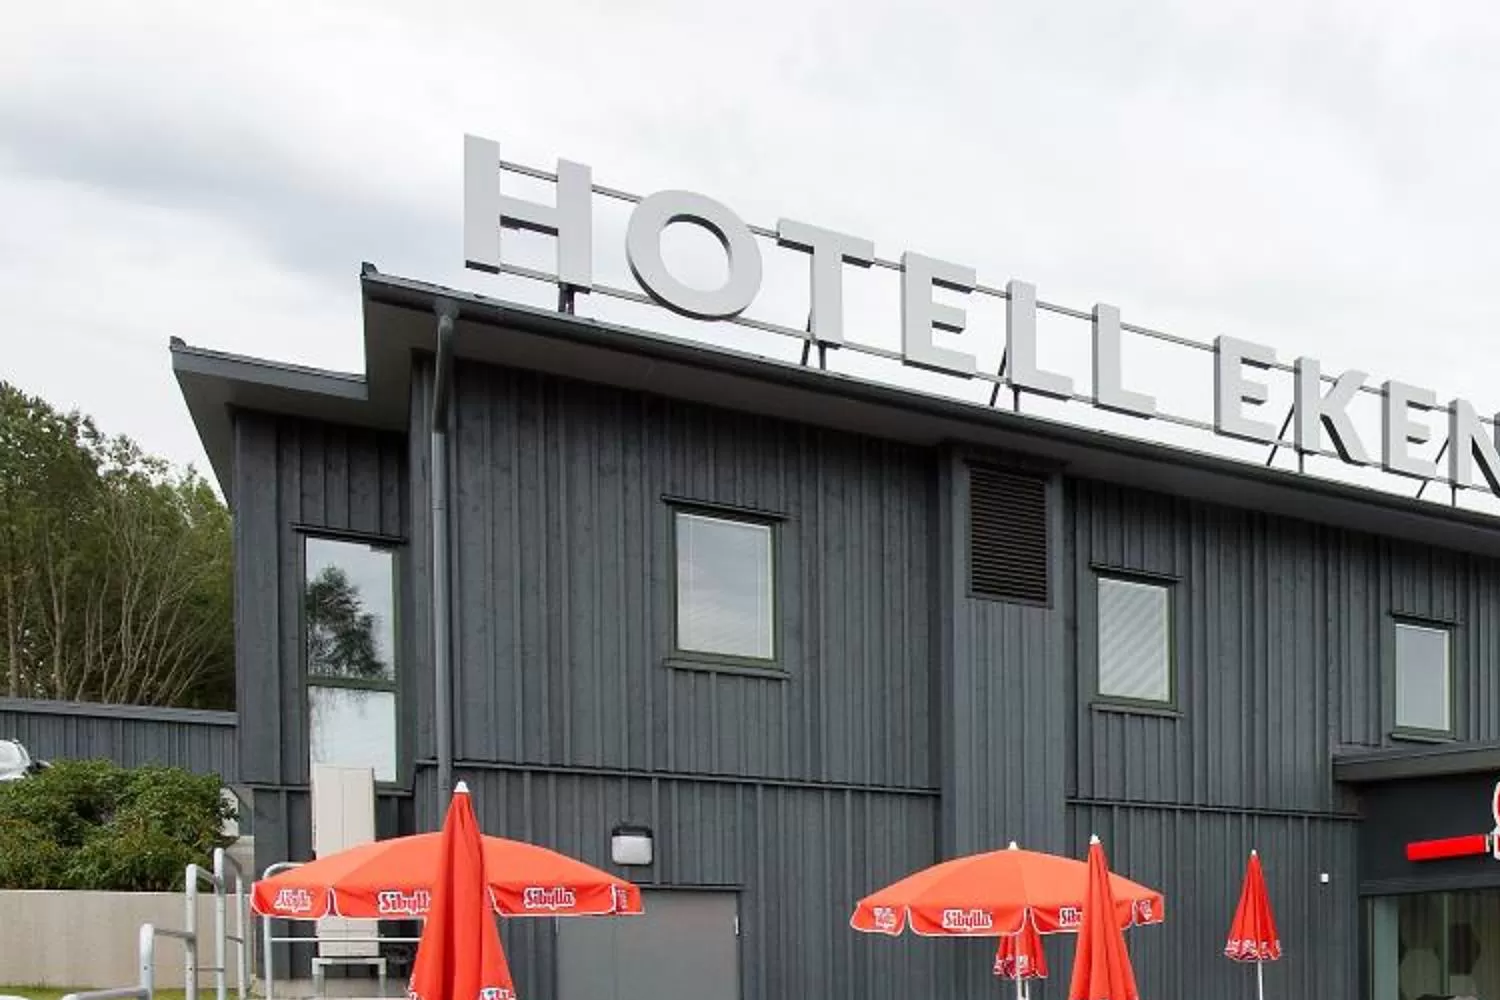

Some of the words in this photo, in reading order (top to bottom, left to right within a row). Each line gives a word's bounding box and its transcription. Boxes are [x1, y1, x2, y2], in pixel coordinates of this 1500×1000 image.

[463, 133, 1158, 420] HOTELL
[380, 891, 430, 914] Sibyll
[943, 909, 992, 930] Sibylla
